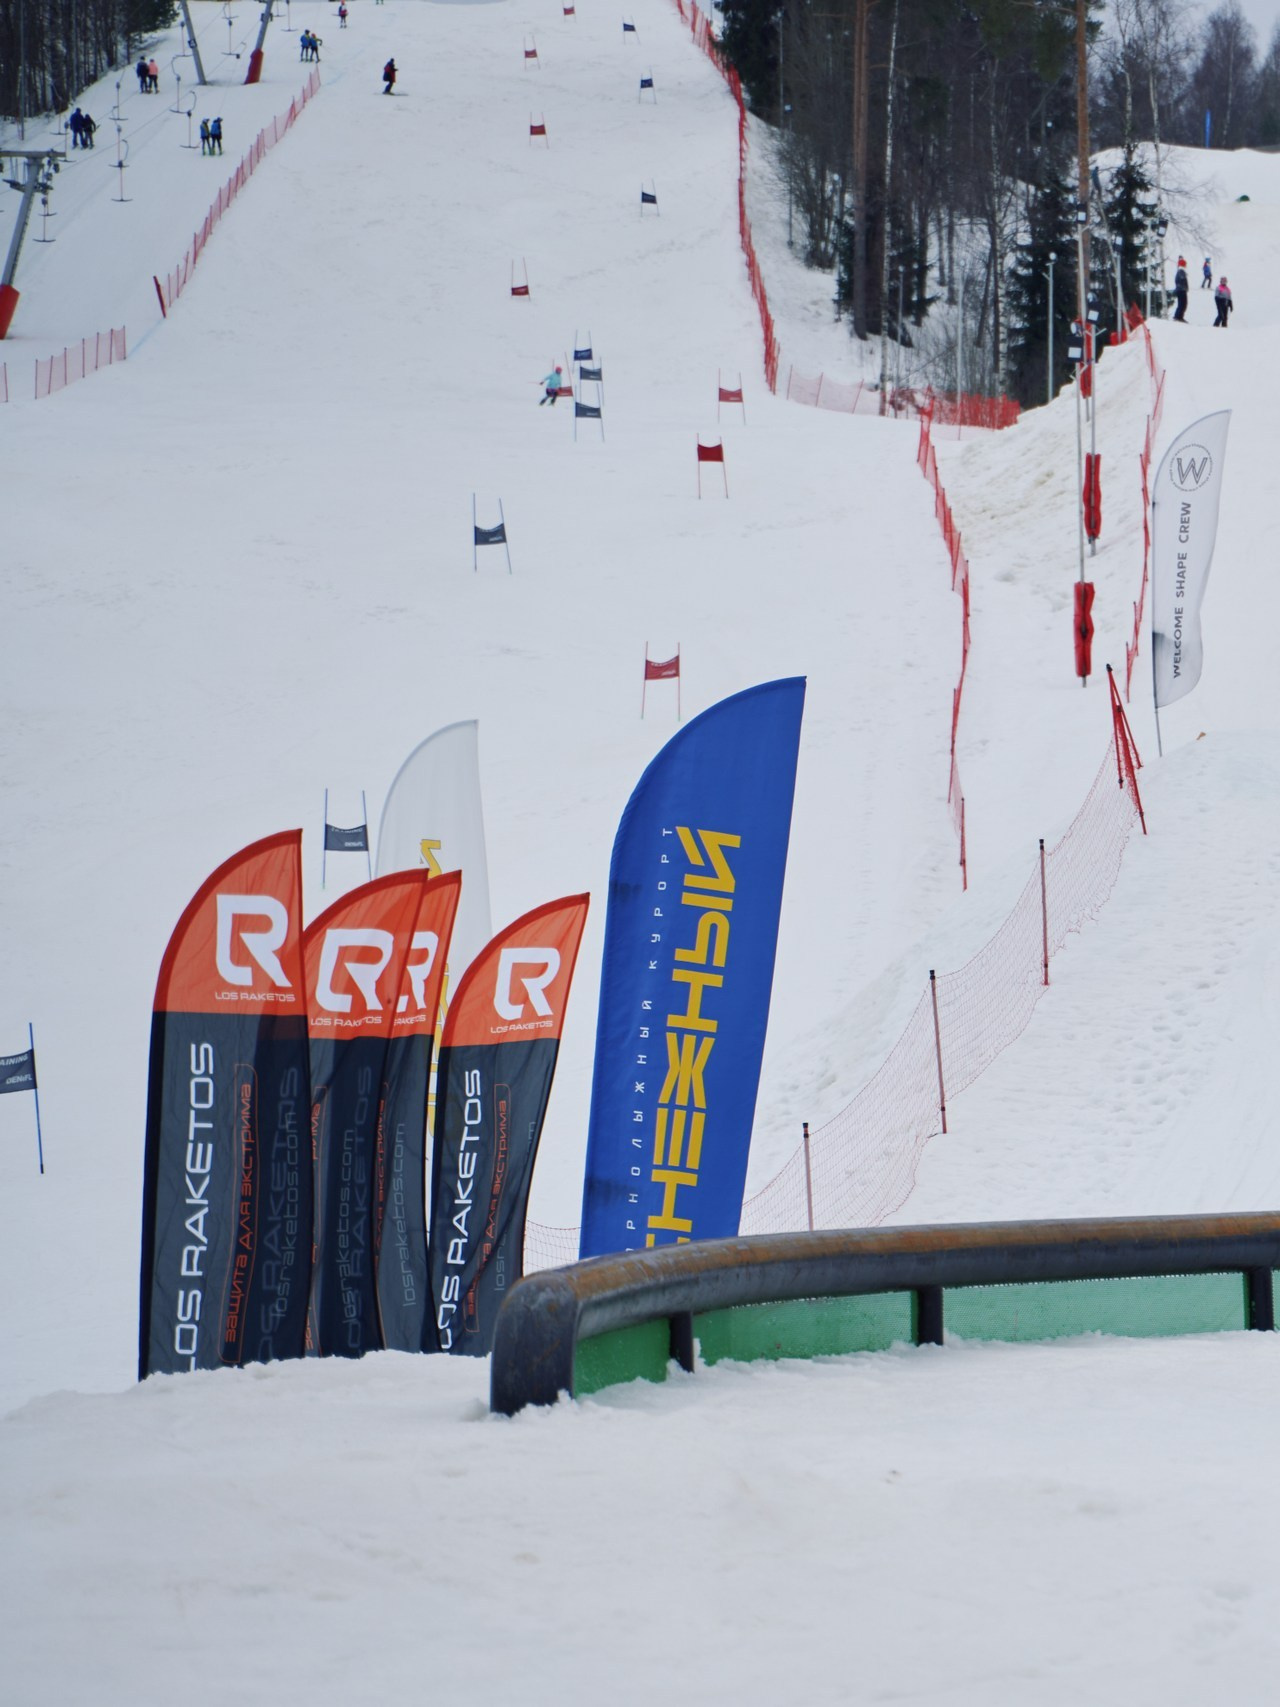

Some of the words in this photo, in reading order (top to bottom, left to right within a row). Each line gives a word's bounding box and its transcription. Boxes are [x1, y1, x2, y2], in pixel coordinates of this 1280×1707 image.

[1176, 457, 1208, 485] W
[1178, 502, 1192, 544] CREW
[1176, 552, 1188, 598] SHAPE
[1173, 607, 1184, 679] WELCOME
[648, 827, 673, 970] КУРОРТ
[215, 992, 239, 1001] LOS
[241, 992, 296, 1003] RAKETOS
[311, 1017, 331, 1026] LOS
[491, 1025, 508, 1034] LOS
[508, 1020, 554, 1031] RAKETOS
[0, 1054, 28, 1066] AINING
[181, 1042, 214, 1277] RAKETOS
[239, 1083, 255, 1197] экстрима
[446, 1069, 482, 1265] RAKETOS
[493, 1098, 508, 1196] экстрима
[239, 1201, 253, 1250] для
[392, 1122, 416, 1306] losraketos.com
[225, 1254, 248, 1343] защита
